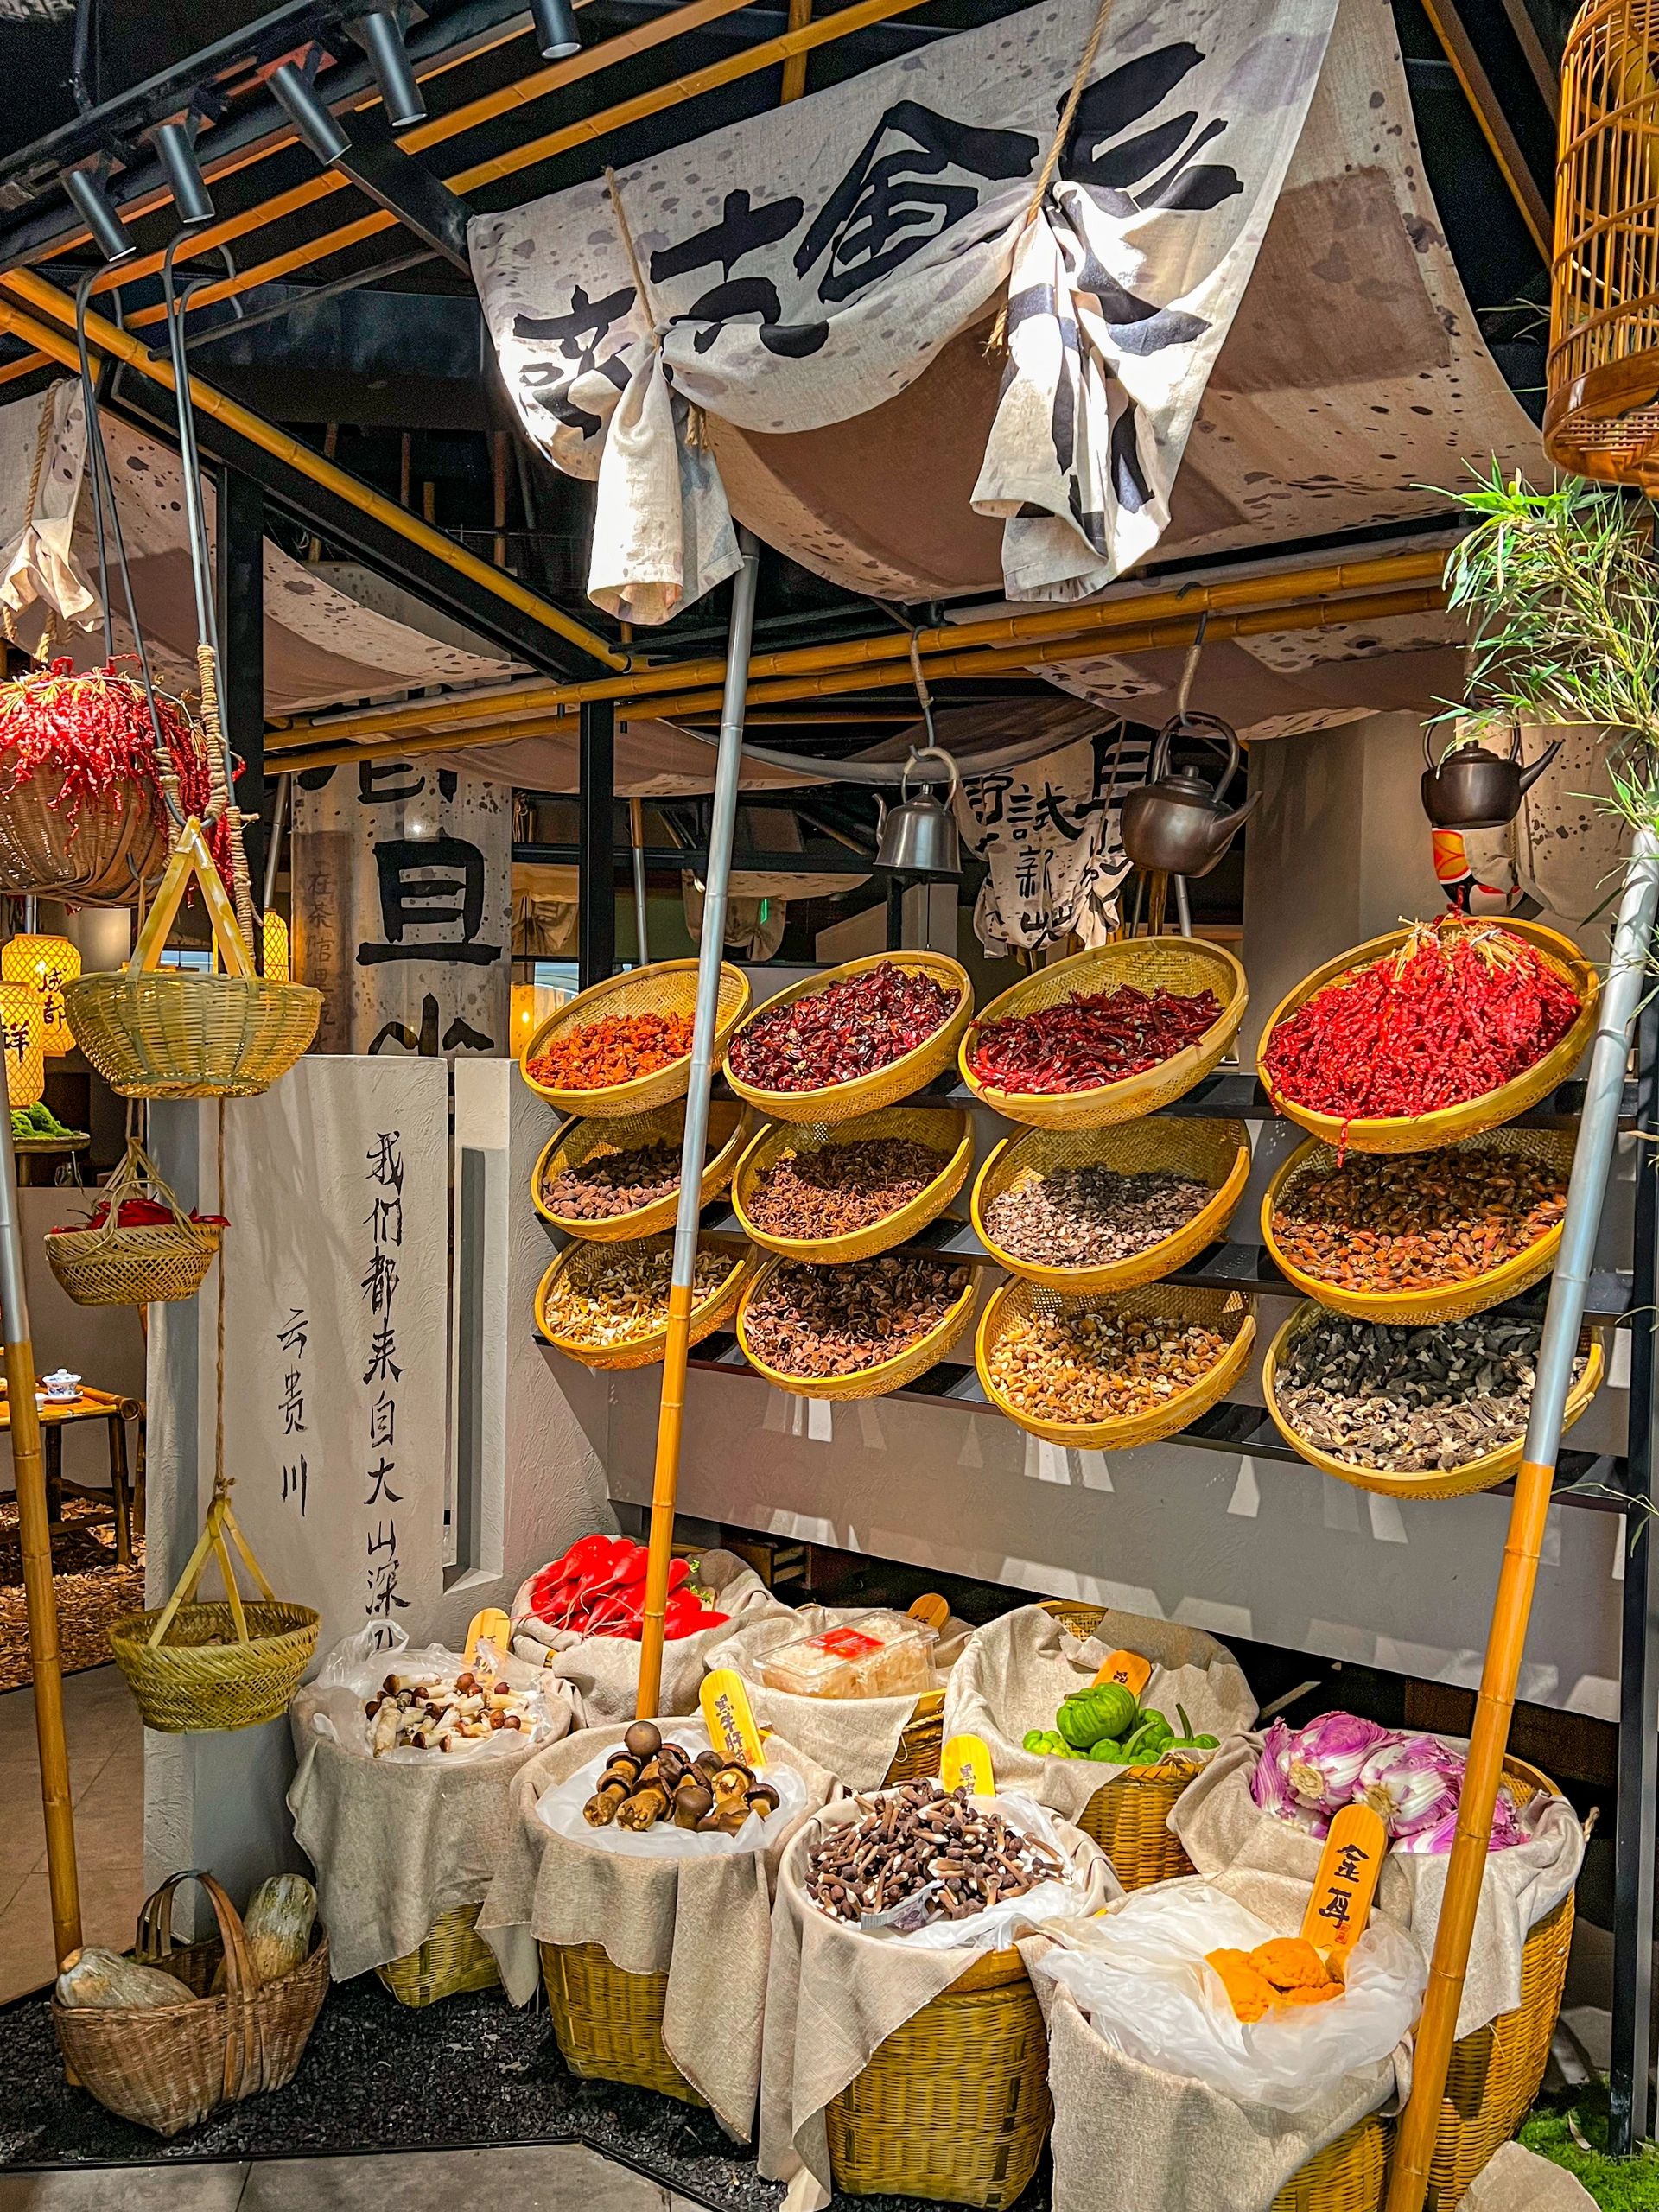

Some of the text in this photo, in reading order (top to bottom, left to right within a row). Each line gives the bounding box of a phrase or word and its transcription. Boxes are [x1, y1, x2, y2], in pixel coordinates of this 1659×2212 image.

[276, 1307, 309, 1517] 云贵川
[1319, 1843, 1370, 1929] 金耳
